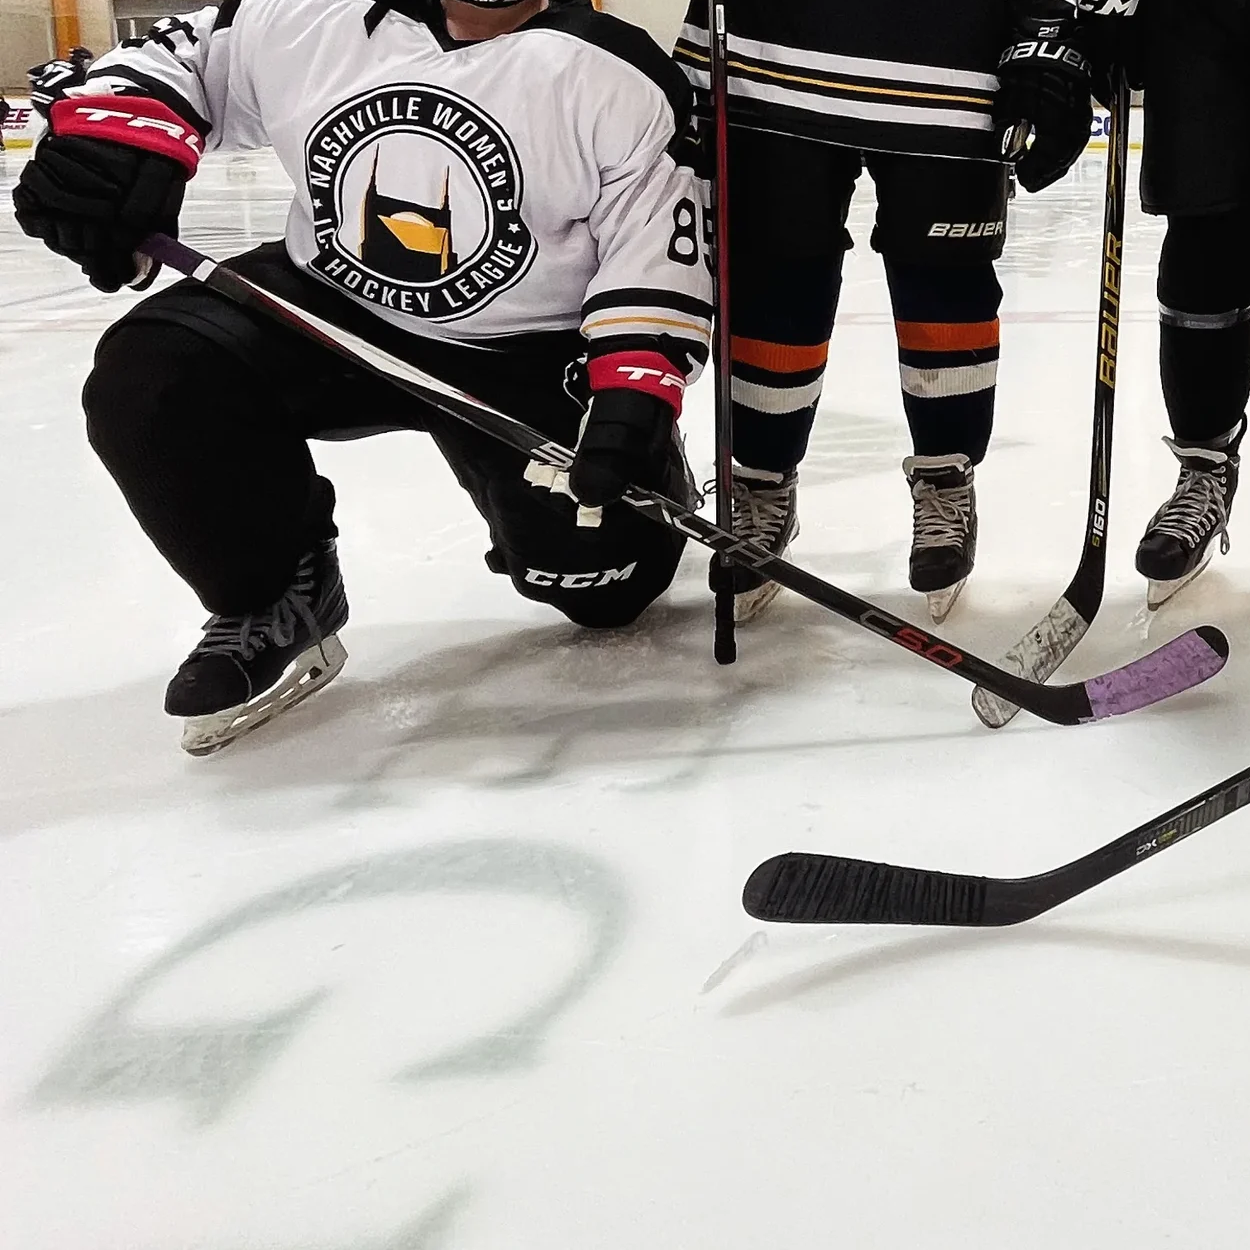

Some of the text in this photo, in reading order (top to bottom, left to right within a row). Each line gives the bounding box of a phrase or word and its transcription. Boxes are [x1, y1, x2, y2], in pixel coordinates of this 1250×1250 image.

[998, 41, 1093, 78] BAUER
[311, 96, 514, 211] NASHVILLE WOMEN'S
[927, 221, 1004, 238] BAUER
[324, 257, 431, 313] HOCKEY
[442, 239, 523, 309] LEAGUE
[1098, 231, 1121, 390] BAUER
[524, 561, 638, 589] CCM
